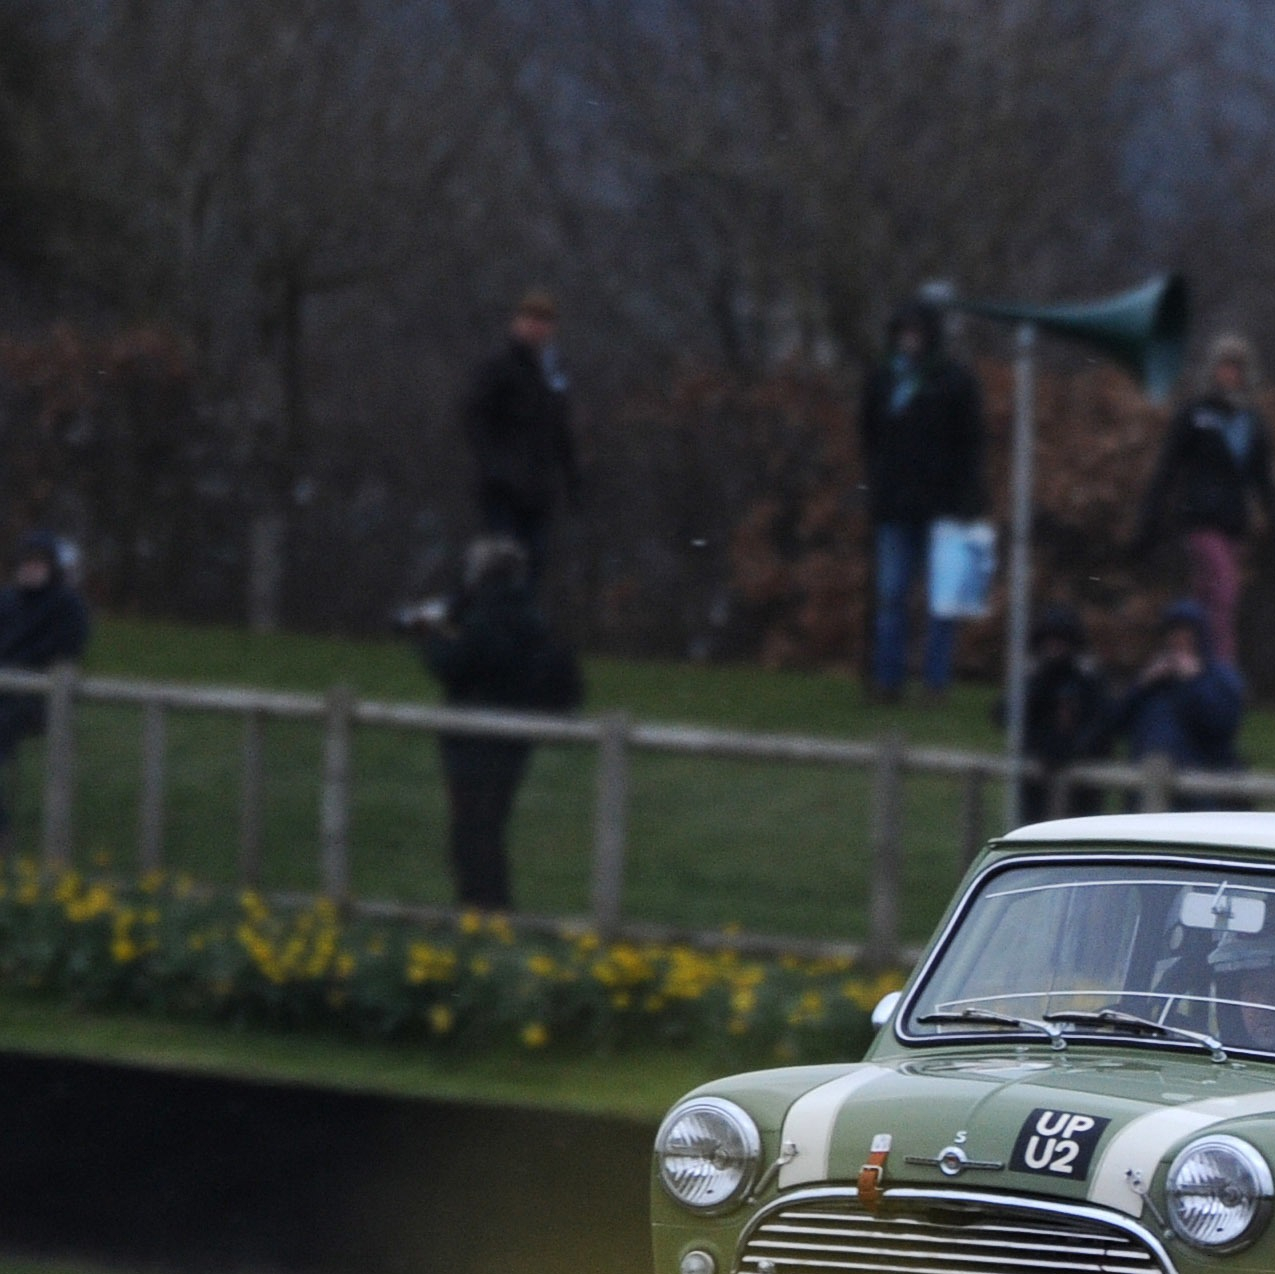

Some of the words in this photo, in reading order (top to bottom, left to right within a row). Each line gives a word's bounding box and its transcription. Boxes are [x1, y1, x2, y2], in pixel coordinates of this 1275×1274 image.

[954, 1130, 968, 1144] S
[1036, 1111, 1095, 1138] UP
[1024, 1136, 1079, 1173] U2
